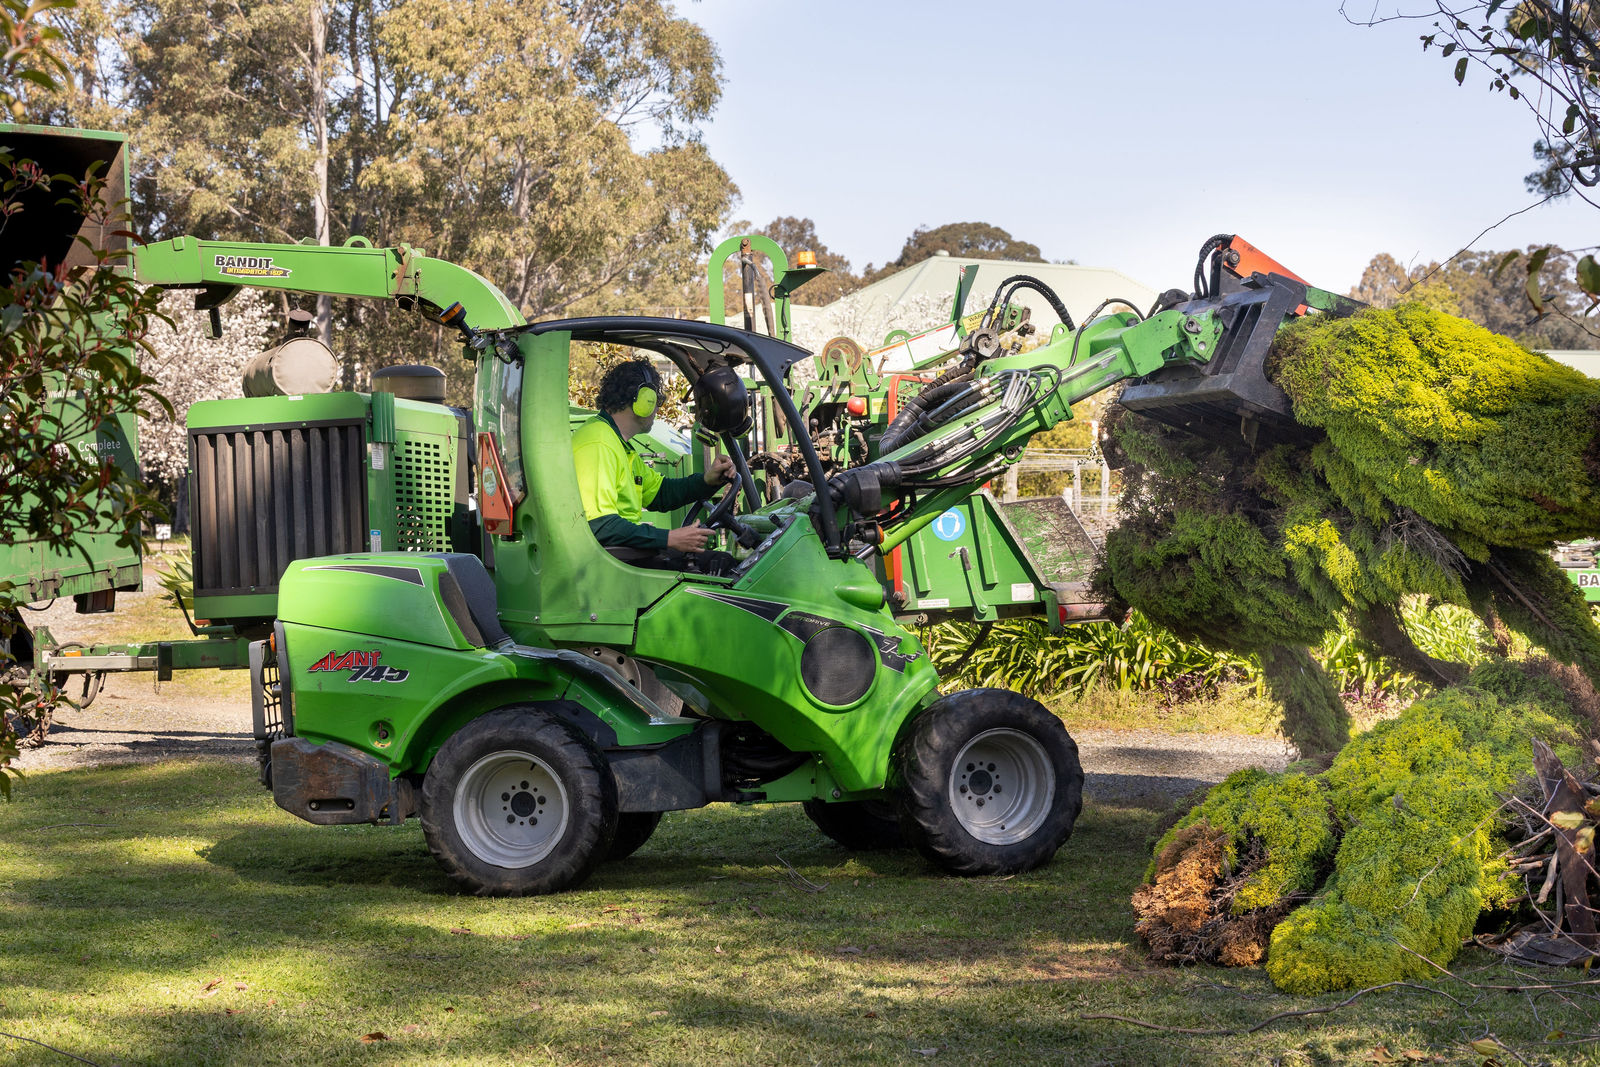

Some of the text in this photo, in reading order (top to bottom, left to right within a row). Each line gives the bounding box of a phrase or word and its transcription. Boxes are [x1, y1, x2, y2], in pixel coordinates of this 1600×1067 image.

[215, 255, 272, 269] BANDIT
[78, 438, 121, 454] Complete
[307, 650, 382, 672] AVANT
[346, 665, 410, 682] 745
